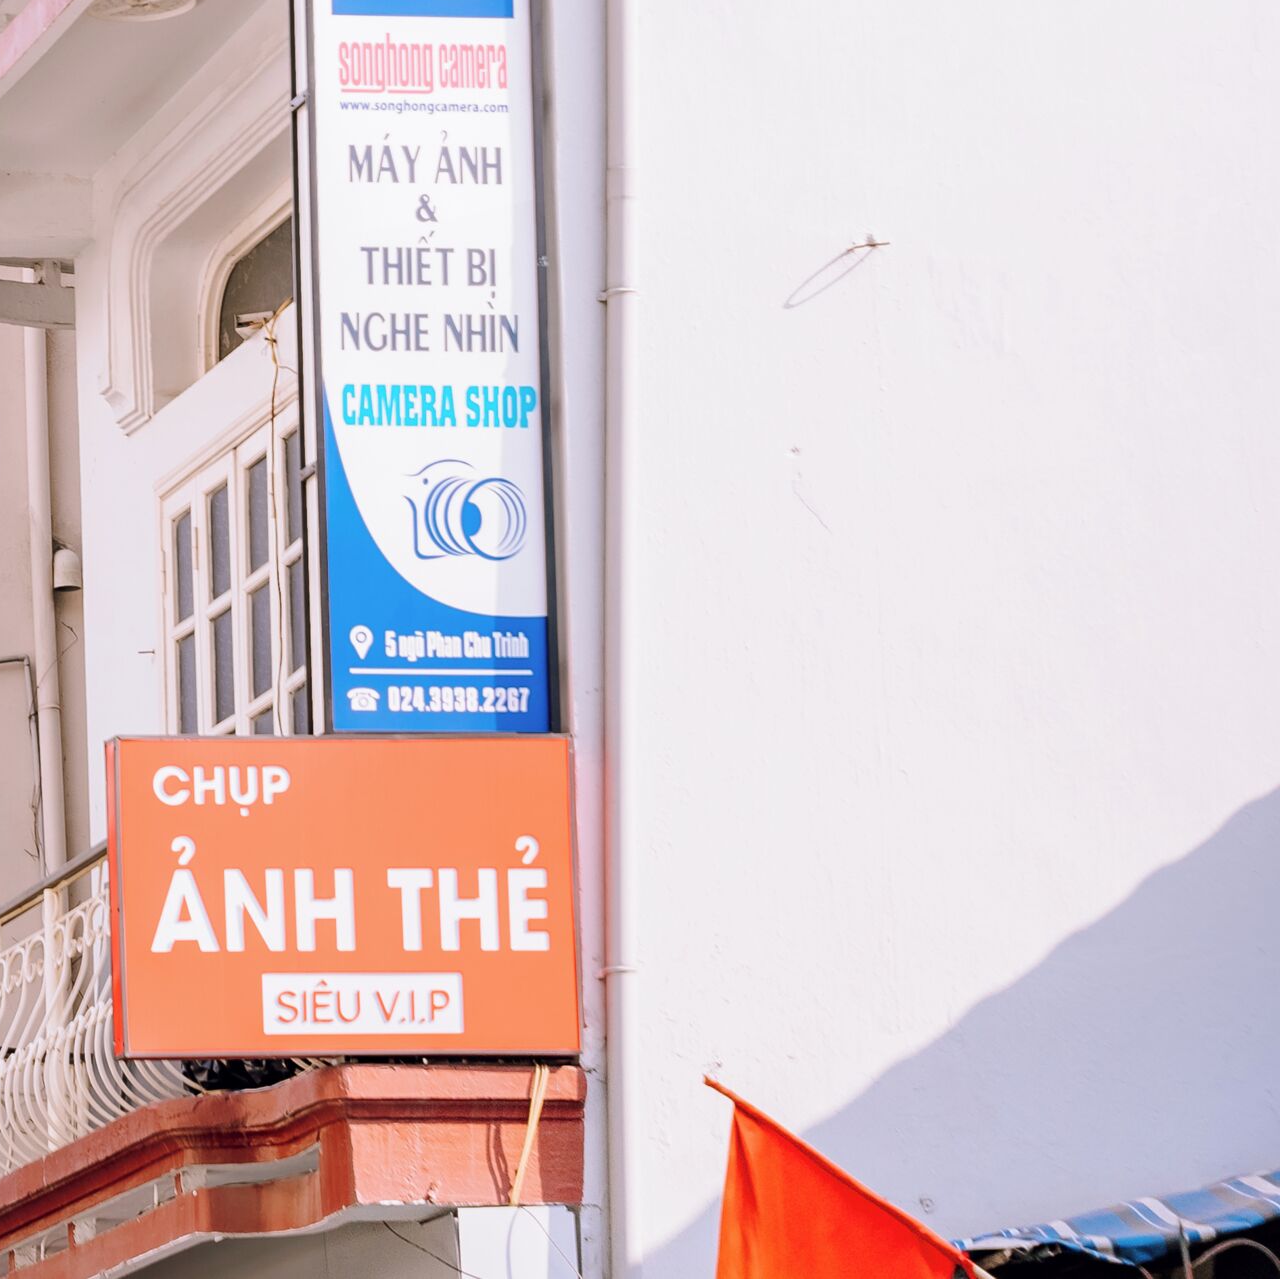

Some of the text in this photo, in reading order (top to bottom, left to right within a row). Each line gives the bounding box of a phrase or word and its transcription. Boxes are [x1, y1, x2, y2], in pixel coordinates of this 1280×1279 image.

[339, 32, 508, 94] songhong camera
[339, 99, 509, 115] www.songhongcamera.com
[348, 130, 502, 185] MÁY ẢNH
[415, 194, 438, 222] &
[360, 231, 496, 299] THIẾT BỊ
[340, 301, 520, 353] NGHE NHÌN
[342, 383, 537, 428] CAMERA SHOP
[385, 630, 397, 657] 5
[426, 630, 462, 658] Phan
[463, 631, 492, 658] Chu
[492, 631, 529, 658] Trinh
[387, 685, 530, 713] 024.3938.2267
[152, 765, 290, 817] CHỤP
[150, 835, 551, 953] ẢNH THẺ
[276, 980, 451, 1024] SIÊU V.I.P
